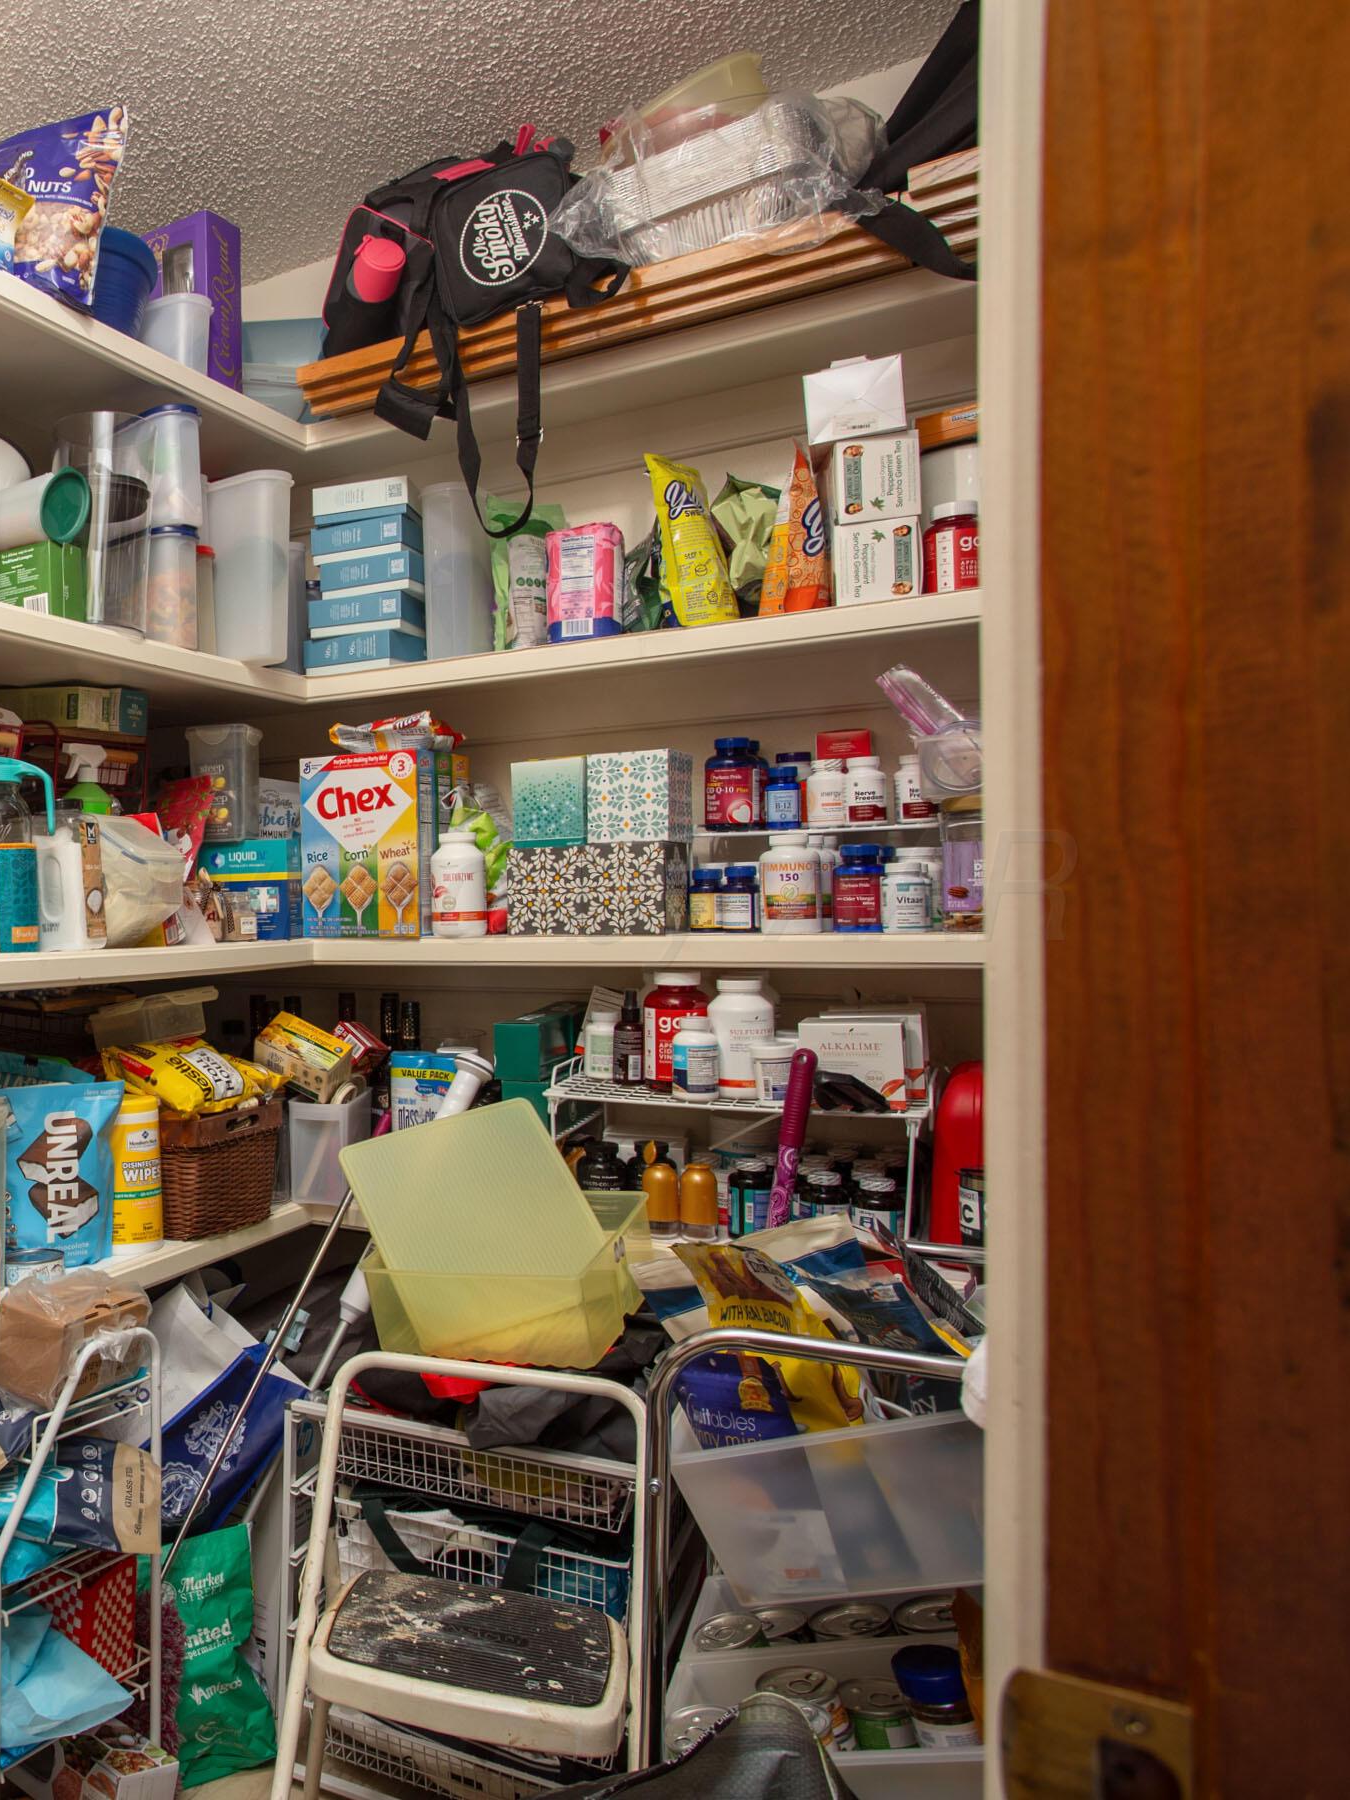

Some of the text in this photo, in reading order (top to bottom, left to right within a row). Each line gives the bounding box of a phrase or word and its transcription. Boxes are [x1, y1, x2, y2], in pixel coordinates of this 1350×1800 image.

[27, 179, 72, 193] NUTS
[501, 193, 531, 261] Moonshine
[473, 203, 516, 279] Smoky
[887, 453, 895, 497] Peppermint
[895, 482, 903, 508] Sencha
[852, 532, 860, 555] Sencha
[397, 759, 406, 773] 3
[316, 782, 397, 820] Chex
[716, 786, 735, 795] Q-10
[228, 850, 258, 863] LIQUID
[307, 850, 328, 864] Rice
[344, 849, 369, 862] Corn
[379, 846, 411, 860] Wheat
[778, 873, 800, 882] 150
[287, 1023, 308, 1037] Lemon
[819, 1042, 881, 1051] ALKALIME
[197, 1058, 223, 1084] TOLL
[197, 1051, 235, 1091] HOUSE
[401, 1069, 451, 1080] VALUE PACK
[44, 1110, 80, 1244] UNREAL
[720, 1306, 741, 1322] WITH
[761, 1310, 791, 1333] BACON!
[178, 1571, 226, 1594] Market
[187, 1617, 232, 1649] nited
